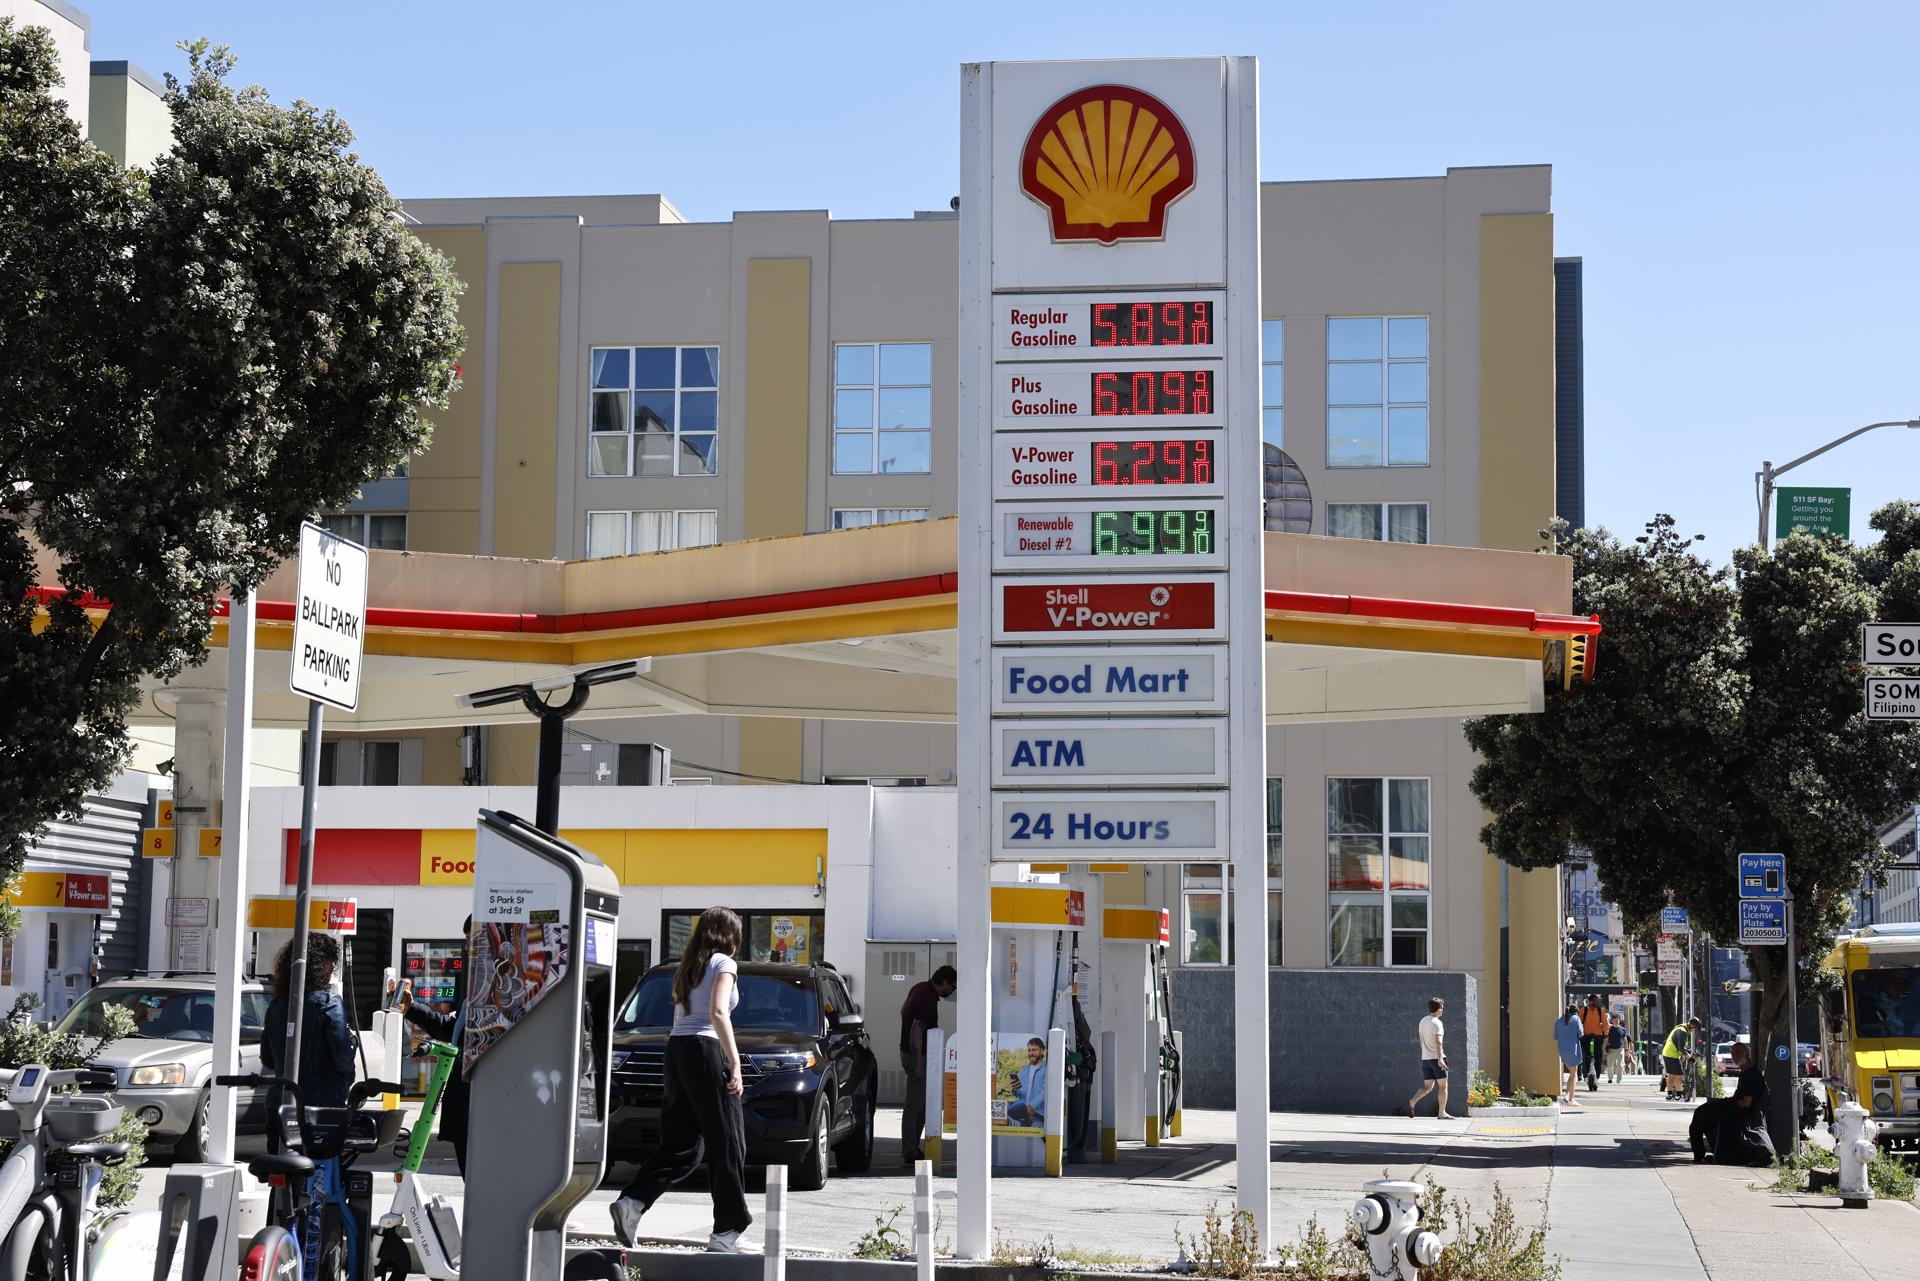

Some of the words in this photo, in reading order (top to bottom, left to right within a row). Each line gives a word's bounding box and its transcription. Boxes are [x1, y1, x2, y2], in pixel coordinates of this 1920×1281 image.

[1011, 308, 1068, 329] Regular
[1095, 303, 1184, 347] 5.89
[1011, 331, 1077, 347] Gasoline
[1011, 377, 1042, 393] Plus
[1095, 372, 1185, 416] 6.09
[1011, 398, 1078, 416] Gasoline
[1012, 447, 1074, 462] V-Power
[1096, 441, 1185, 486] 6.29
[1011, 468, 1078, 485] Gasoline
[1791, 505, 1819, 513] Getting
[1017, 517, 1074, 531] Renewable
[1095, 511, 1186, 556] 6.99
[1019, 537, 1051, 551] Diesel
[1055, 537, 1072, 551] #2
[326, 559, 342, 586] NO
[1045, 588, 1089, 605] Shell
[303, 596, 359, 639] BALLPARK
[1047, 607, 1161, 628] V-Power
[1877, 632, 1920, 656] So
[303, 644, 350, 683] PARKING
[1010, 664, 1092, 694] Food
[1105, 667, 1189, 693] Mart
[1874, 683, 1920, 699] SOM
[1874, 702, 1915, 715] Filipino
[1011, 740, 1084, 767] ATM
[164, 809, 173, 821] 6
[1010, 812, 1054, 840] 24
[1068, 813, 1170, 840] Hours
[154, 838, 162, 849] 8
[214, 836, 222, 847] 7
[1742, 859, 1760, 868] Pay
[1760, 859, 1781, 867] here
[56, 882, 64, 898] 7
[489, 896, 495, 904] S
[497, 896, 515, 904] Park
[516, 896, 525, 904] St
[1743, 903, 1758, 912] Pay
[1760, 903, 1771, 912] by
[322, 909, 327, 923] 5
[514, 907, 522, 915] St
[1743, 911, 1774, 919] License
[1743, 919, 1764, 927] Plate
[1744, 929, 1781, 937] 20305003
[205, 1178, 214, 1188] 02
[413, 1217, 422, 1235] Lime
[422, 1239, 431, 1257] Uber
